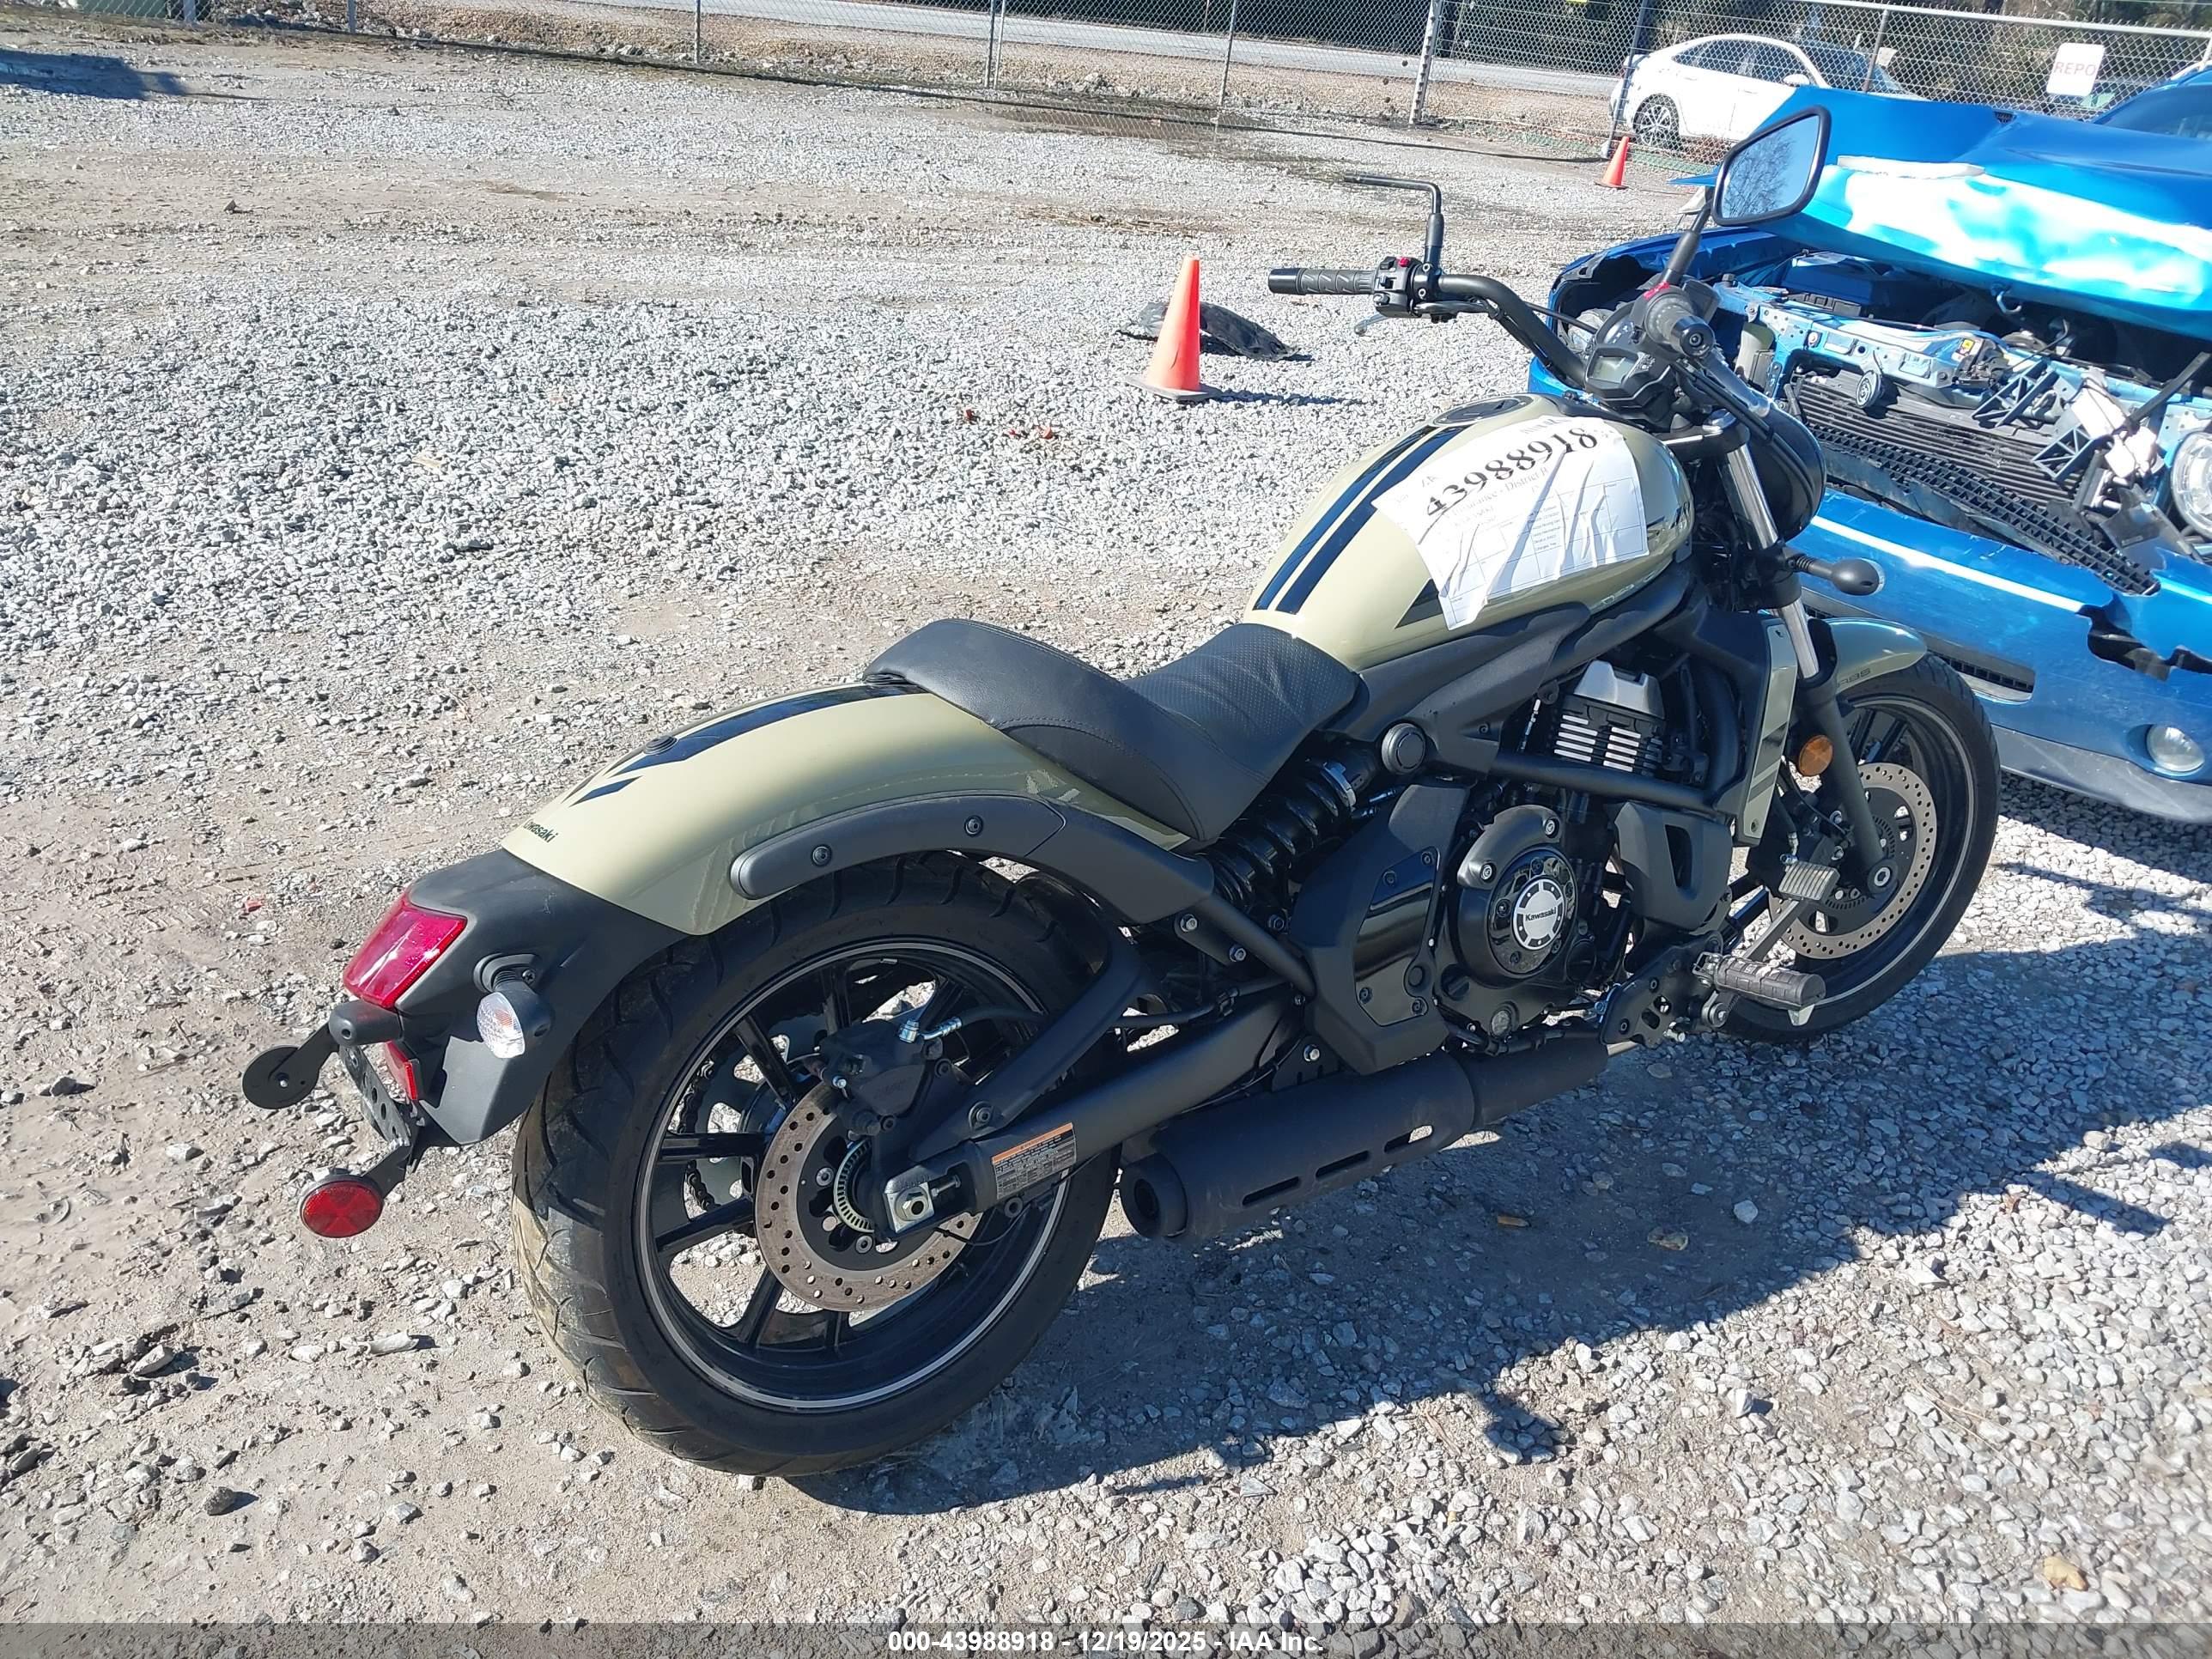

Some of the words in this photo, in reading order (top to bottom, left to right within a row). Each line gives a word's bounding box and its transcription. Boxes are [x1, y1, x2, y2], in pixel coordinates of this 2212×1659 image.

[2054, 61, 2096, 76] REPO
[1426, 427, 1598, 516] 43988918
[523, 818, 558, 843] awasaki
[1525, 906, 1556, 922] Kawasaki
